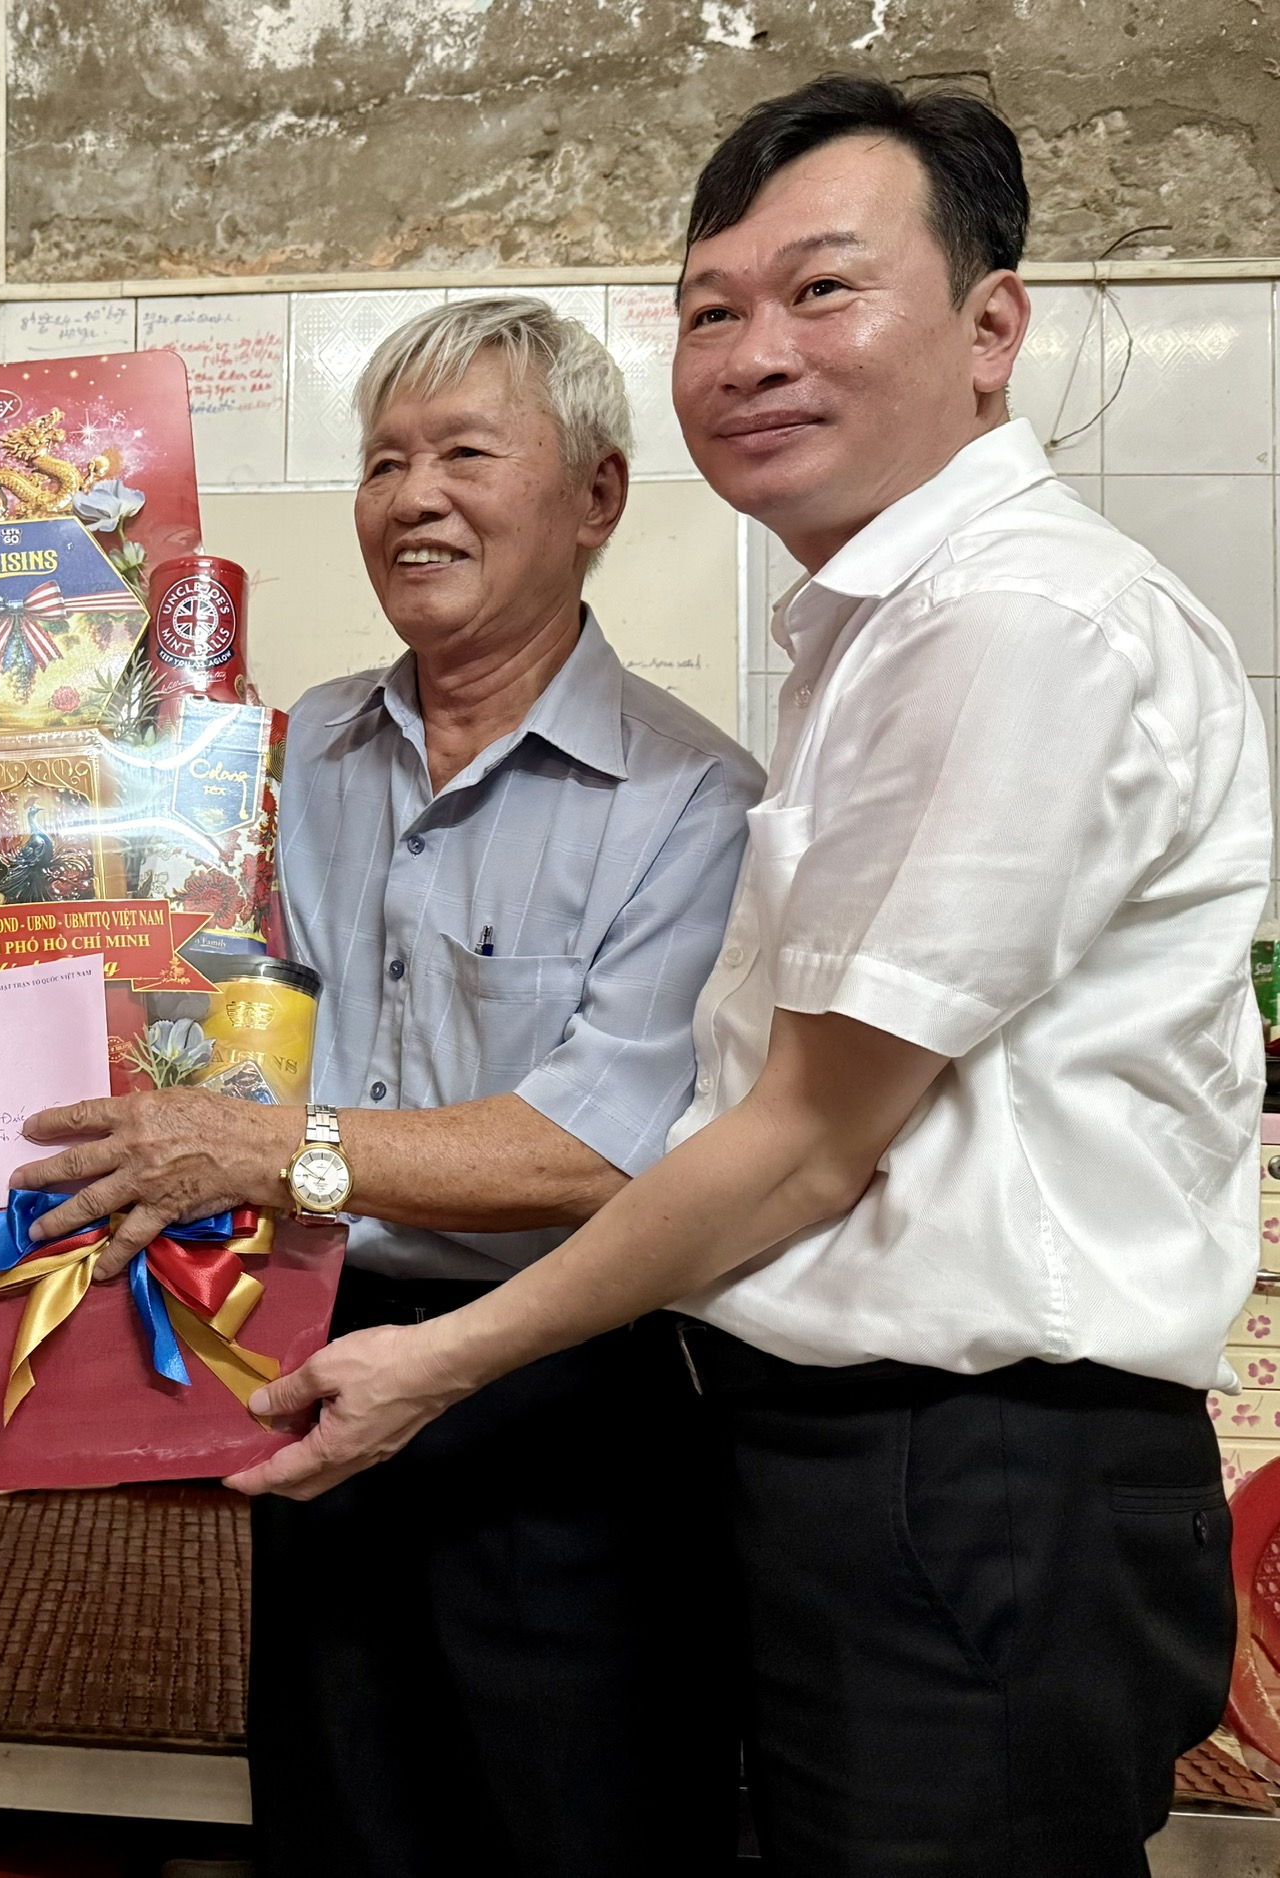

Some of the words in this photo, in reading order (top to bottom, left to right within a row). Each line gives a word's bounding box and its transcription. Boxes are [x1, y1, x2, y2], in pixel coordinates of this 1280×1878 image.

[3, 535, 20, 544] GO
[162, 582, 200, 614] UNCLE
[162, 627, 191, 654] MINT
[174, 658, 190, 667] YOU
[207, 652, 231, 667] AGLOW
[27, 915, 57, 932] UBND
[64, 911, 110, 930] UBMTTQ
[111, 908, 138, 930] VIỆT
[139, 909, 164, 927] NAM
[71, 933, 101, 950] CHÍ
[105, 933, 151, 948] MINH
[76, 969, 92, 977] NAM
